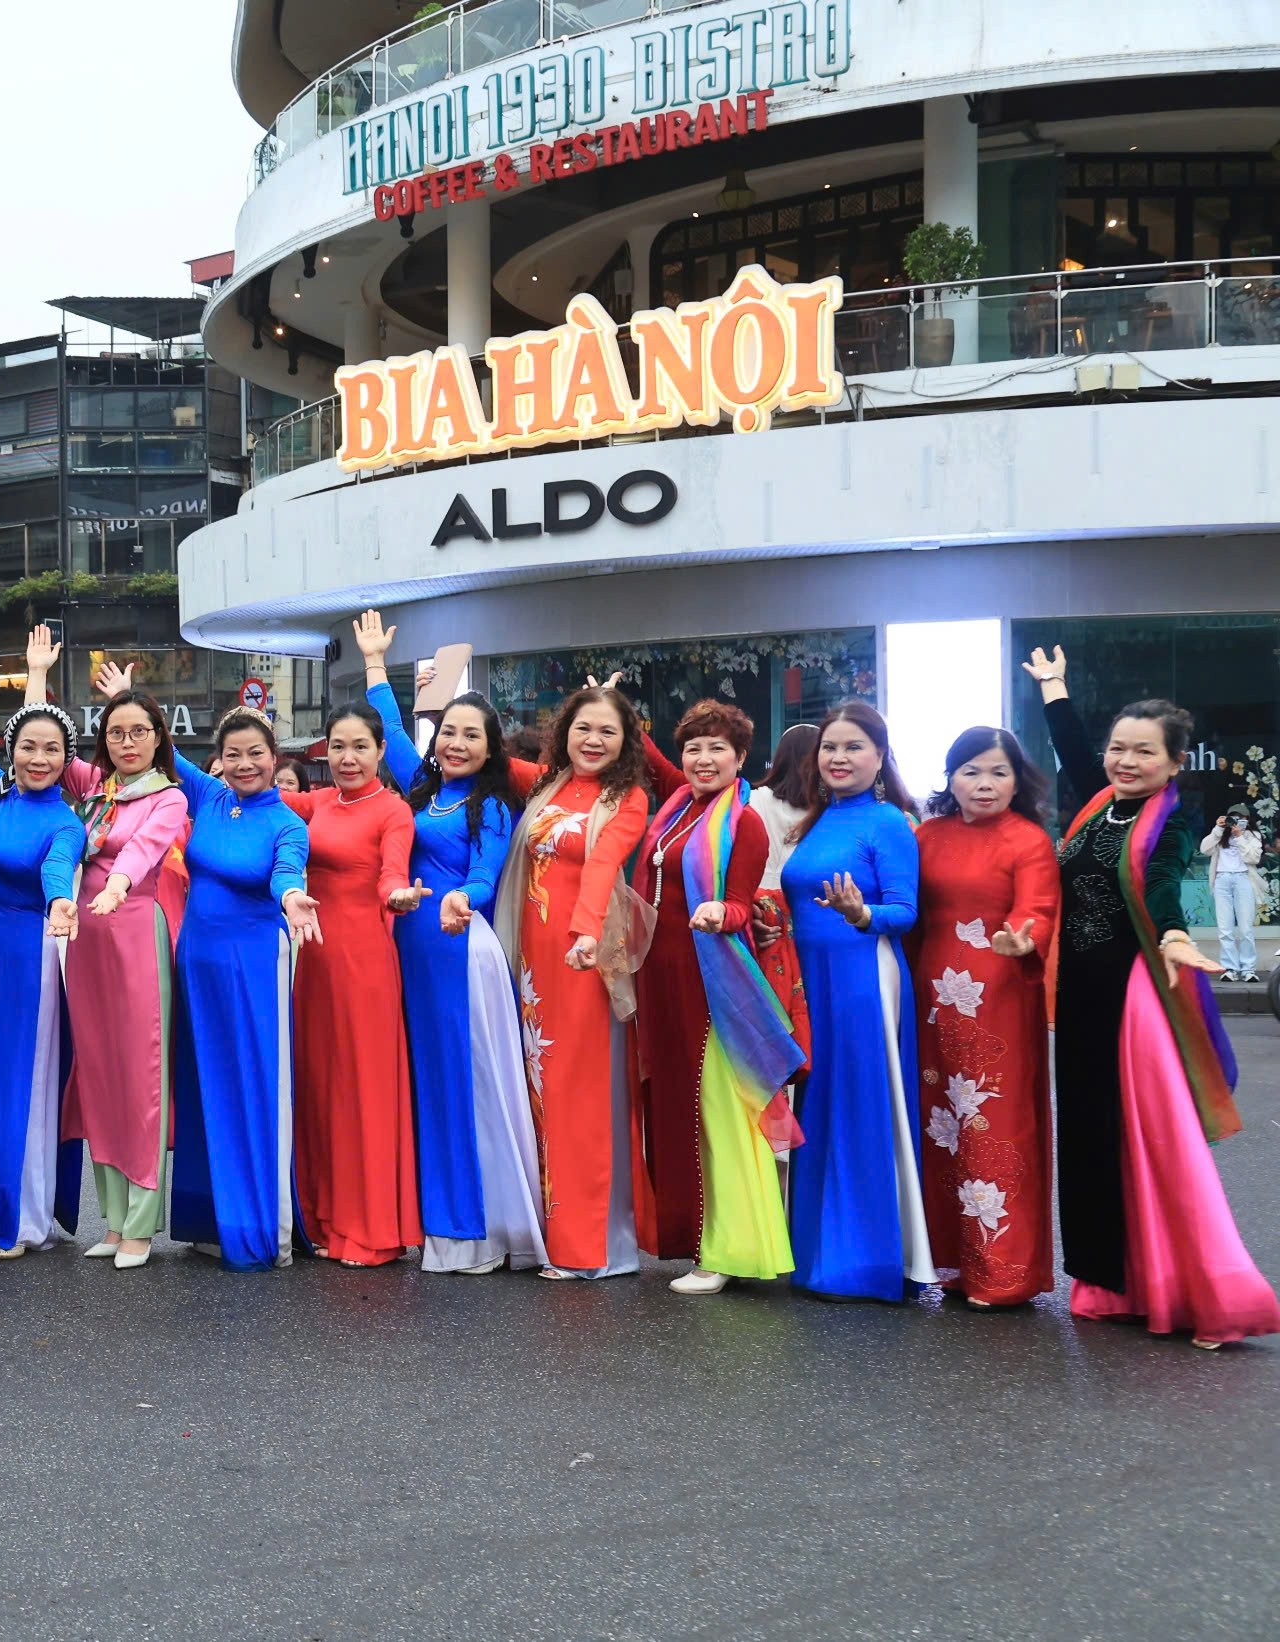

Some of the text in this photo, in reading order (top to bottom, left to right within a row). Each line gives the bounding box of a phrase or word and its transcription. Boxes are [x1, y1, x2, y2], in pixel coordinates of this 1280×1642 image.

[341, 0, 851, 195] HANOI 1930 BISTRO
[374, 88, 775, 222] COFFEE & RESTAURANT
[338, 278, 828, 463] BIA HÀ NỘI
[430, 469, 679, 548] ALDO
